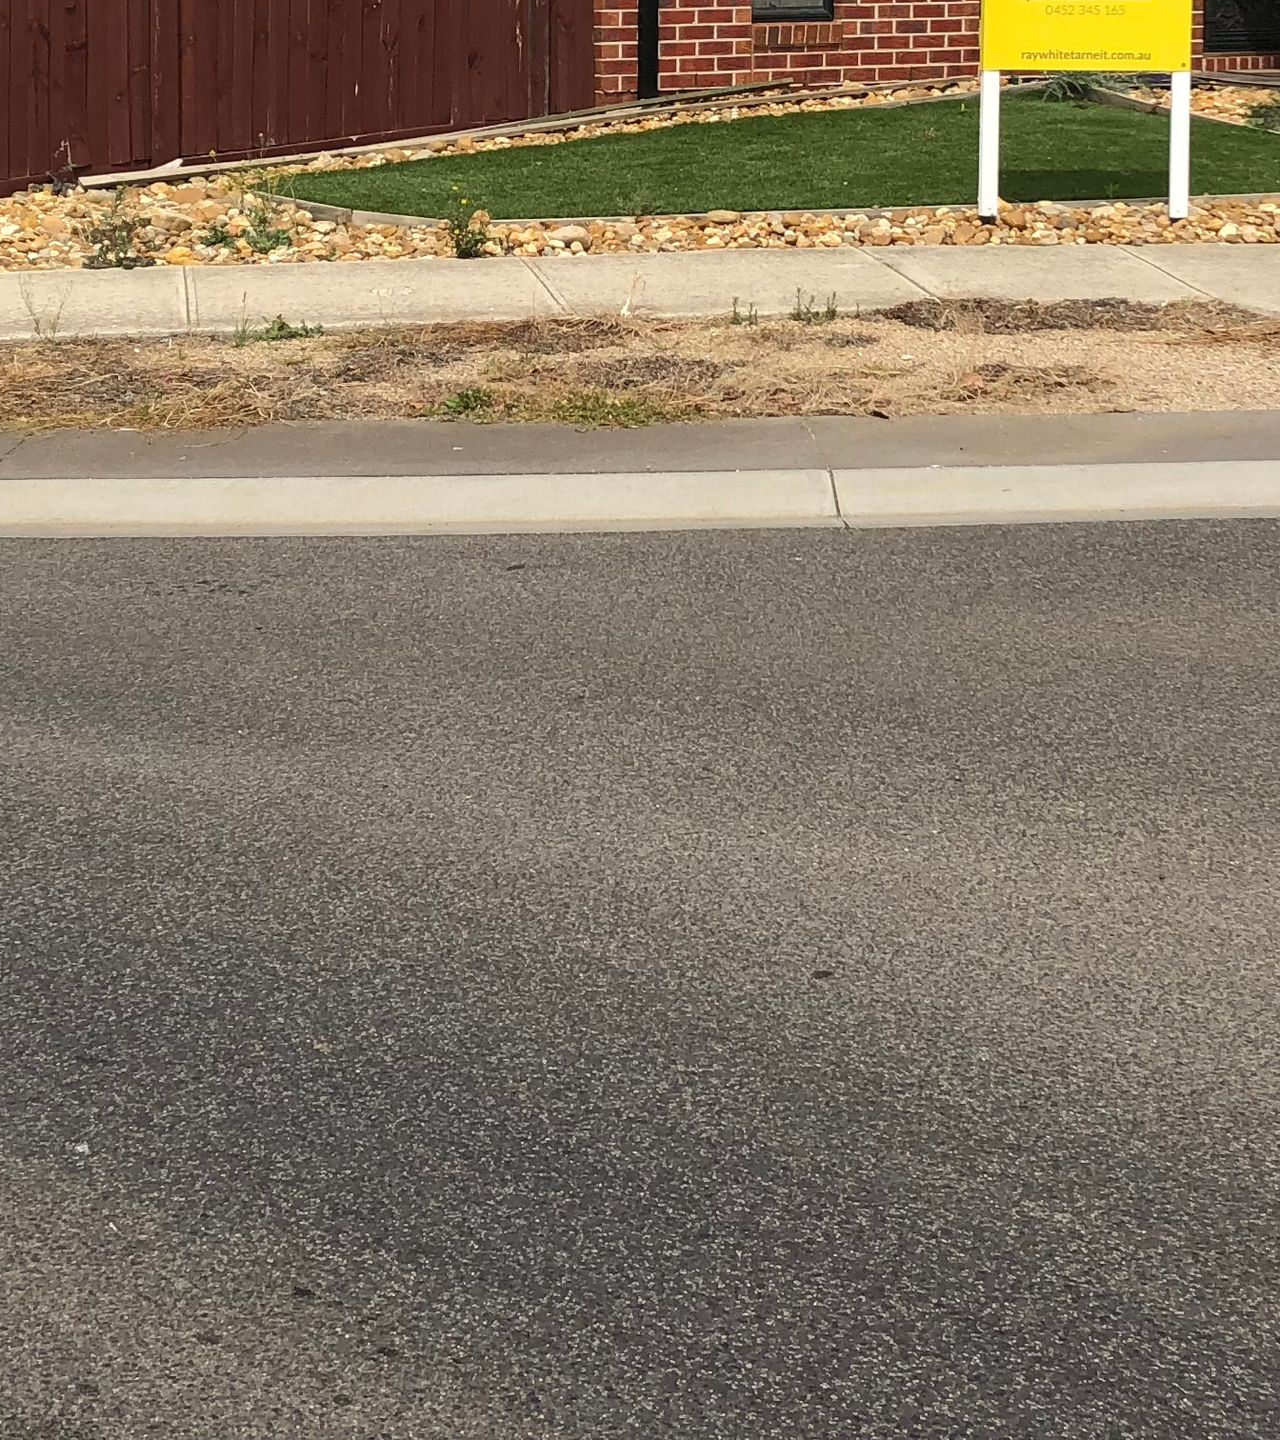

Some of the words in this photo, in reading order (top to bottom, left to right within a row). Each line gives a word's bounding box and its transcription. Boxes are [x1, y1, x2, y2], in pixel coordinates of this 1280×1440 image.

[1045, 4, 1075, 16] 0452
[1078, 4, 1101, 16] 345
[1105, 4, 1126, 16] 165
[1020, 49, 1152, 62] raywhitetarneit.com.au
